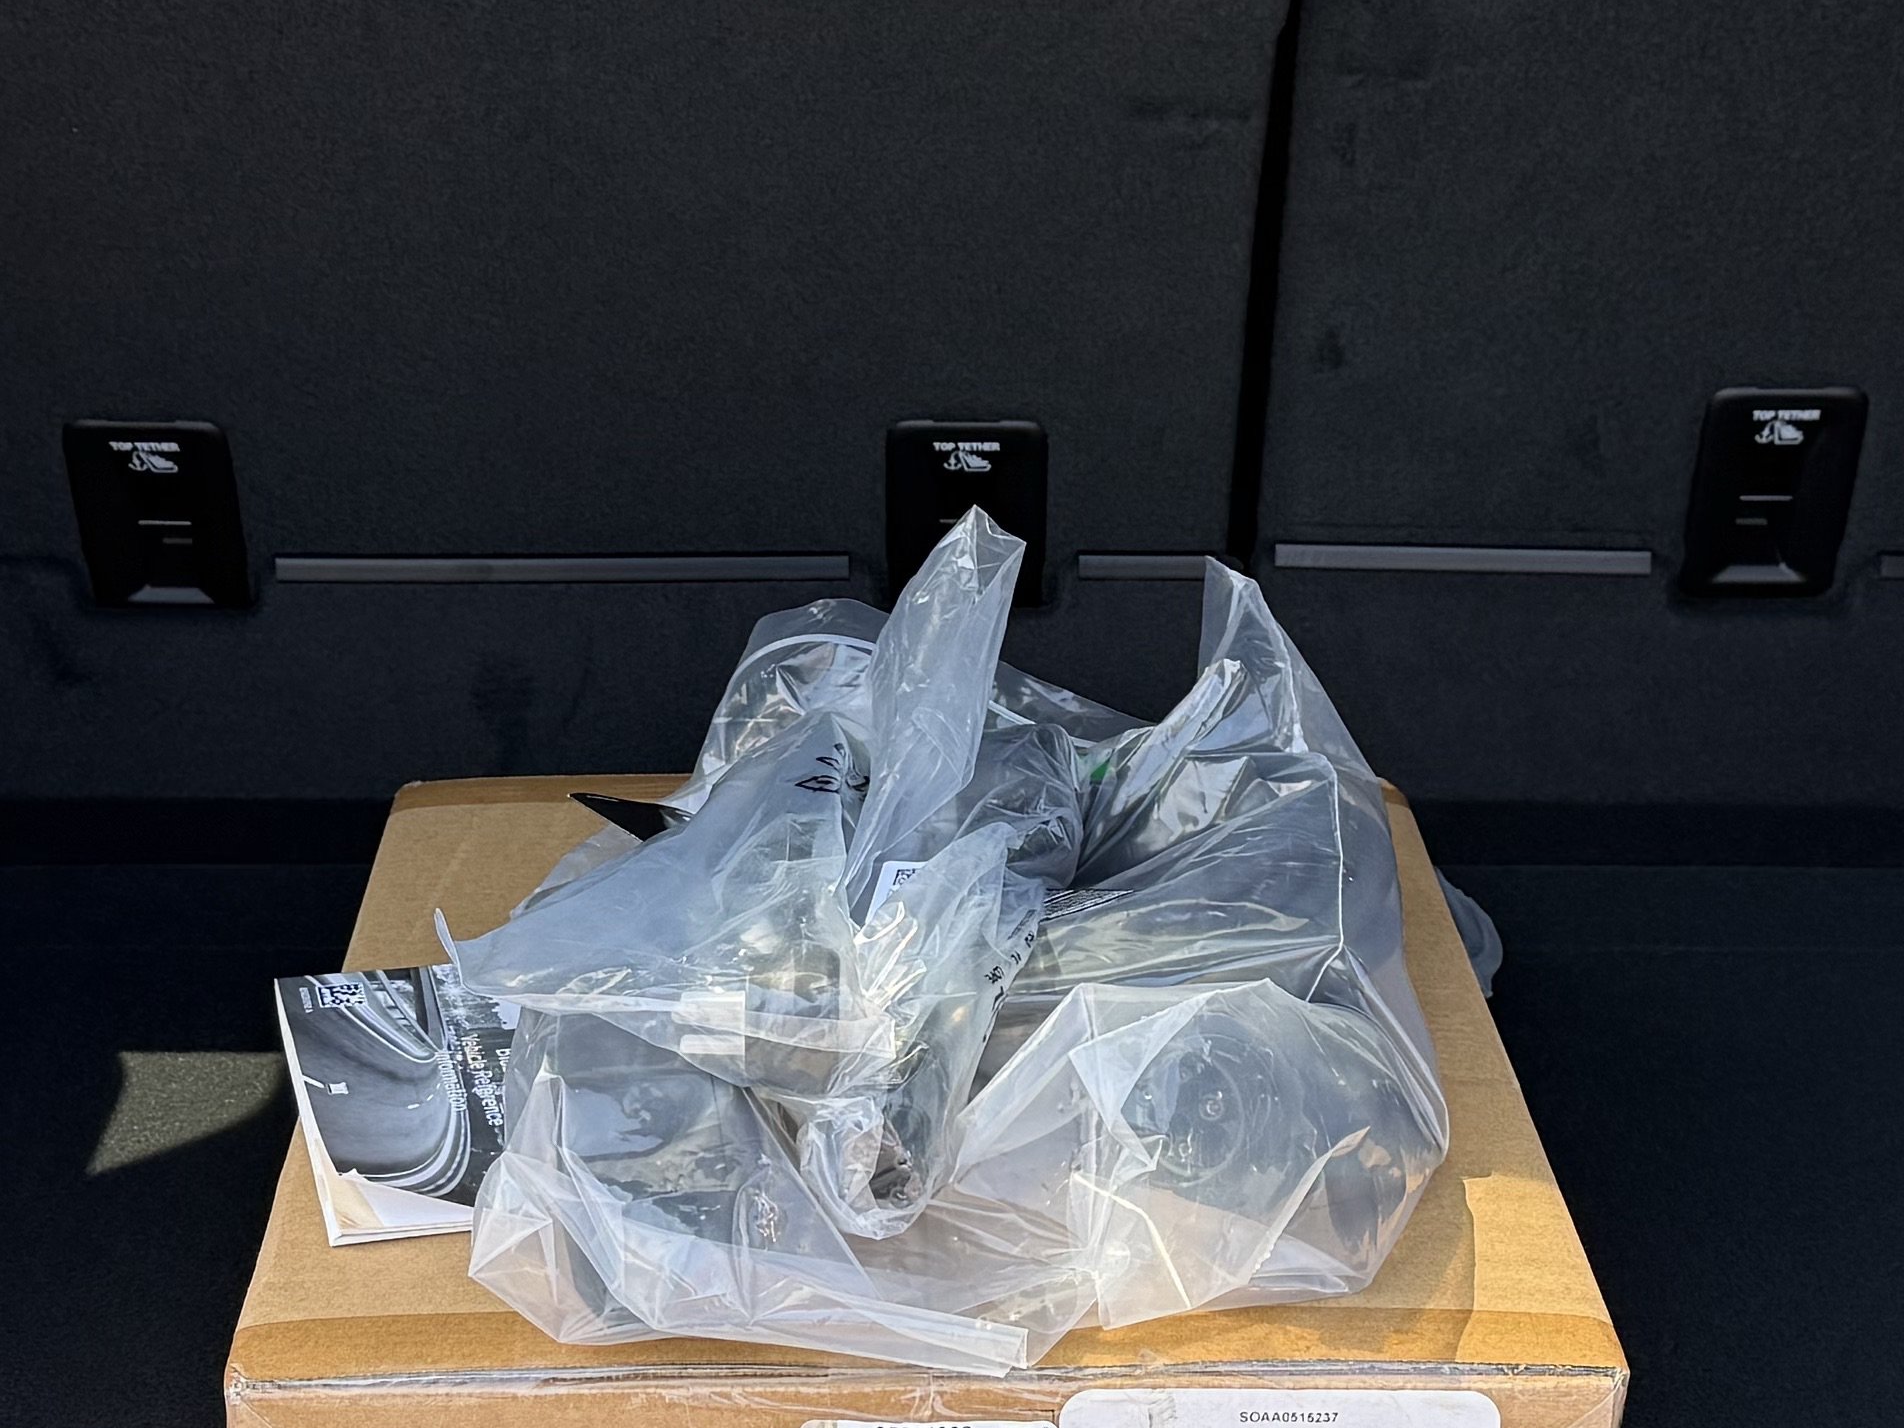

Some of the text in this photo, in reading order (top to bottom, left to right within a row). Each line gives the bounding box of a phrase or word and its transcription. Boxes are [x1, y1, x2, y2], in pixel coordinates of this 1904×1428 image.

[1752, 409, 1821, 421] TOP TETHER
[109, 441, 180, 452] TOP TETHER
[933, 442, 1000, 452] TOP TETHER
[460, 1033, 487, 1071] Vehicle
[471, 1069, 504, 1127] Reference
